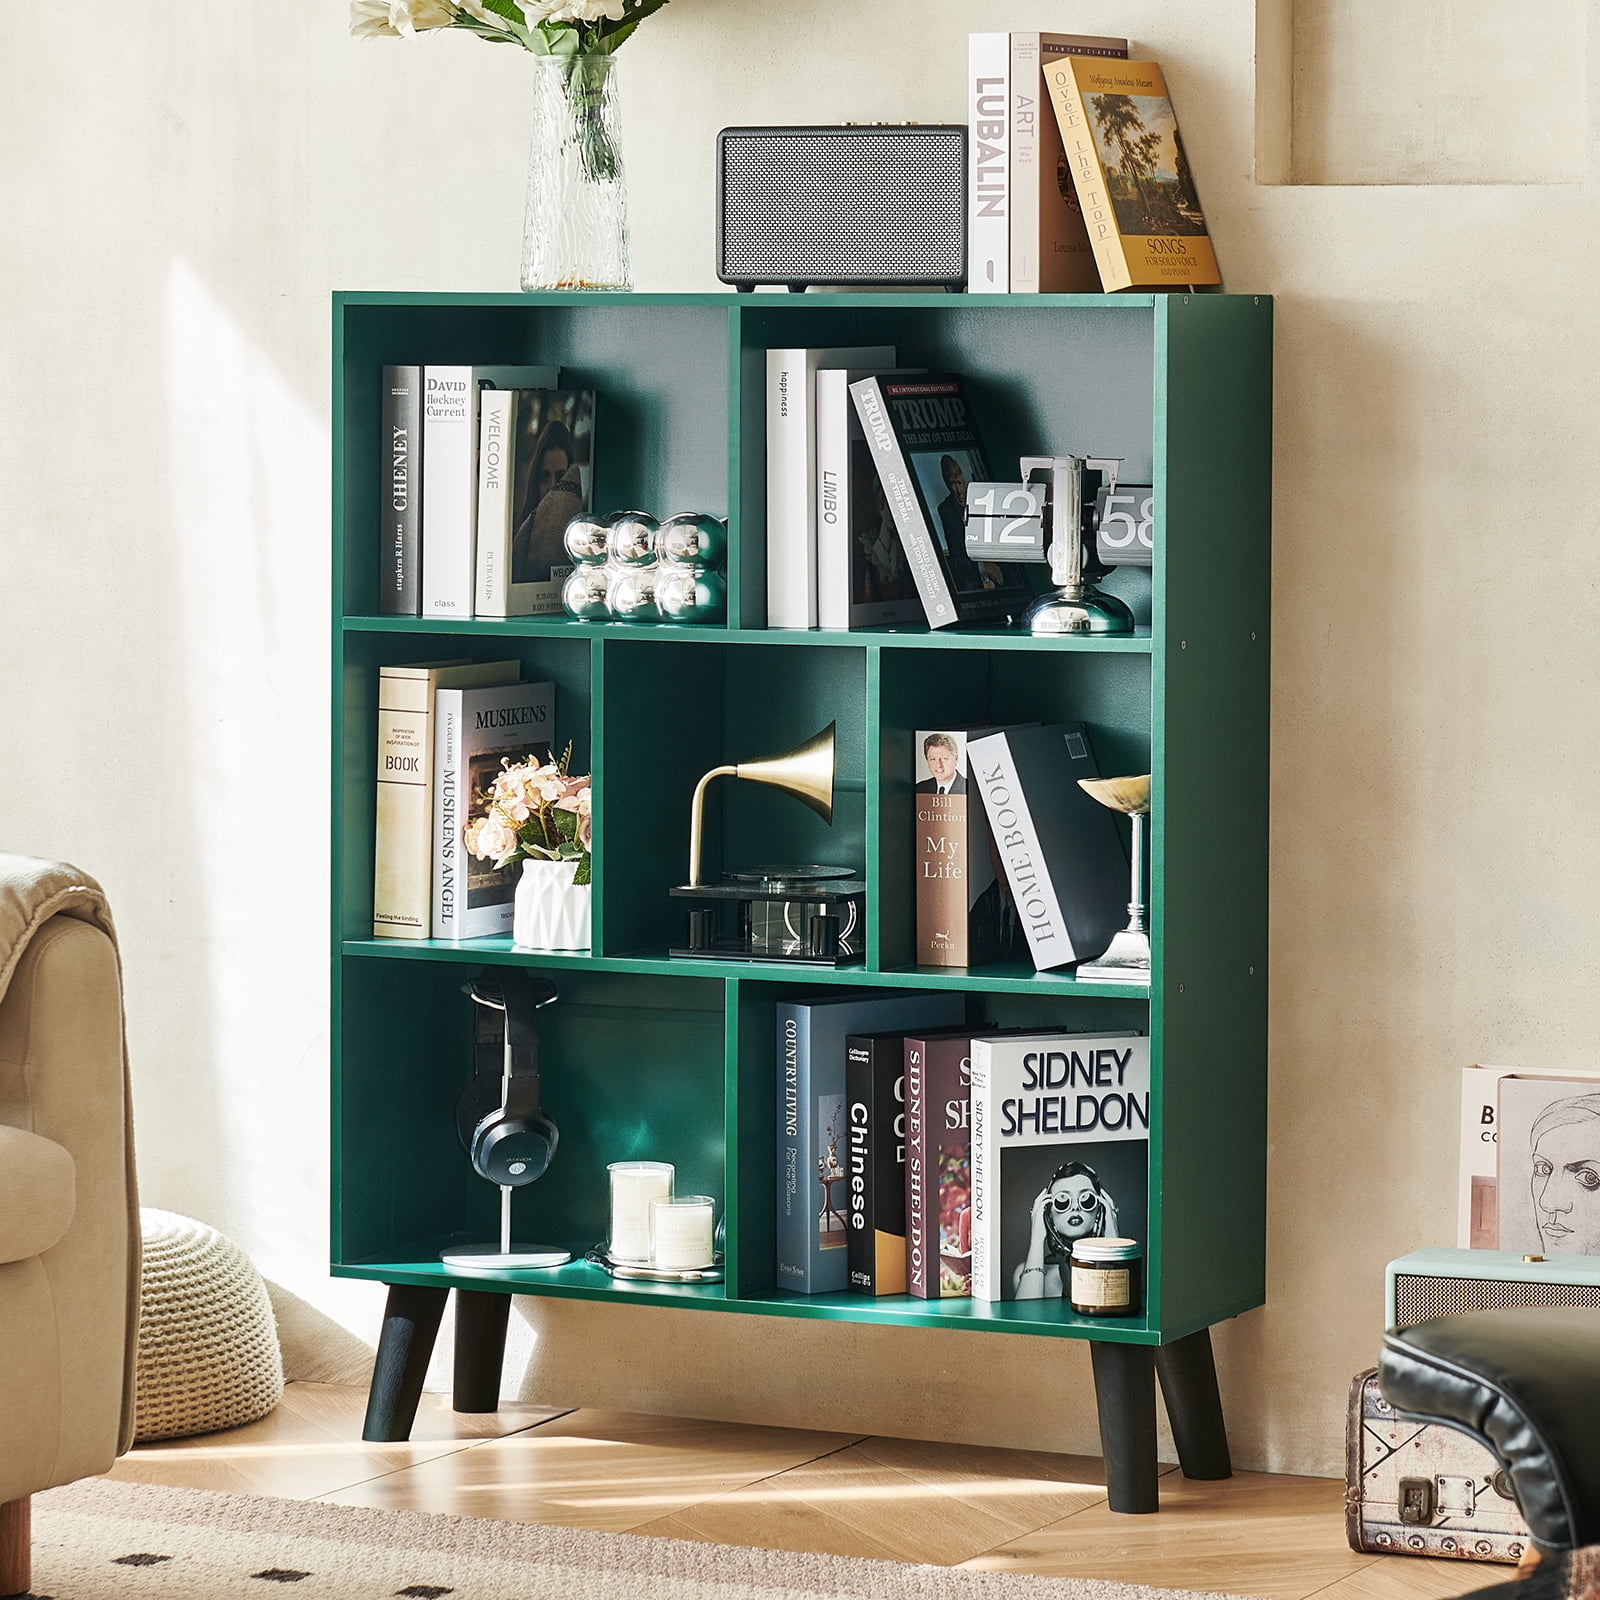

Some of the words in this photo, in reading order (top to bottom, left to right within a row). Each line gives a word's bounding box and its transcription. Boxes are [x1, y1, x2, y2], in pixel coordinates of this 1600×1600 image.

[1049, 45, 1081, 54] BANTAM
[1016, 94, 1034, 138] ART
[976, 77, 1005, 217] LUBALIN
[1055, 72, 1079, 126] Over
[1076, 140, 1093, 181] the
[1087, 191, 1108, 239] Top
[1145, 256, 1158, 266] FOR
[1158, 256, 1177, 266] SOLO
[1176, 256, 1198, 266] VOICE
[1147, 238, 1187, 255] SONGS
[427, 378, 466, 392] DAVID
[427, 394, 466, 407] Hockney
[779, 371, 789, 417] happiness
[426, 406, 466, 417] Current
[860, 387, 893, 452] TRUMP
[891, 397, 966, 430] TRUMP
[486, 409, 502, 489] WELCOME
[902, 433, 918, 444] THE
[919, 432, 931, 444] ART
[931, 432, 941, 443] OF
[941, 431, 956, 442] THE
[956, 429, 976, 441] DEAL
[392, 425, 408, 511] CHENEY
[898, 478, 909, 496] THE
[823, 470, 837, 525] LIMBO
[892, 484, 902, 502] THE
[897, 500, 910, 523] DEAL
[903, 496, 914, 512] ART
[974, 489, 1037, 544] 12
[434, 599, 456, 608] class
[475, 704, 546, 730] MUSIKENS
[385, 755, 419, 772] BOOK
[442, 769, 455, 859] MUSIKENS
[932, 797, 952, 807] Bill
[982, 763, 1026, 849] BOOK
[923, 861, 962, 879] Life
[926, 836, 959, 859] My
[441, 863, 455, 924] ANGEL
[1010, 852, 1056, 943] HOME
[785, 1019, 797, 1086] COUNTRY
[1022, 1047, 1132, 1090] SIDNEY
[785, 1086, 797, 1136] LIVING
[909, 1050, 921, 1153] SIDNEY
[1001, 1091, 1149, 1136] SHELDON
[975, 1100, 983, 1153] SIDNEY
[850, 1102, 868, 1230] Chinese
[975, 1153, 983, 1221] SHELDON
[910, 1157, 922, 1288] SHELDON
